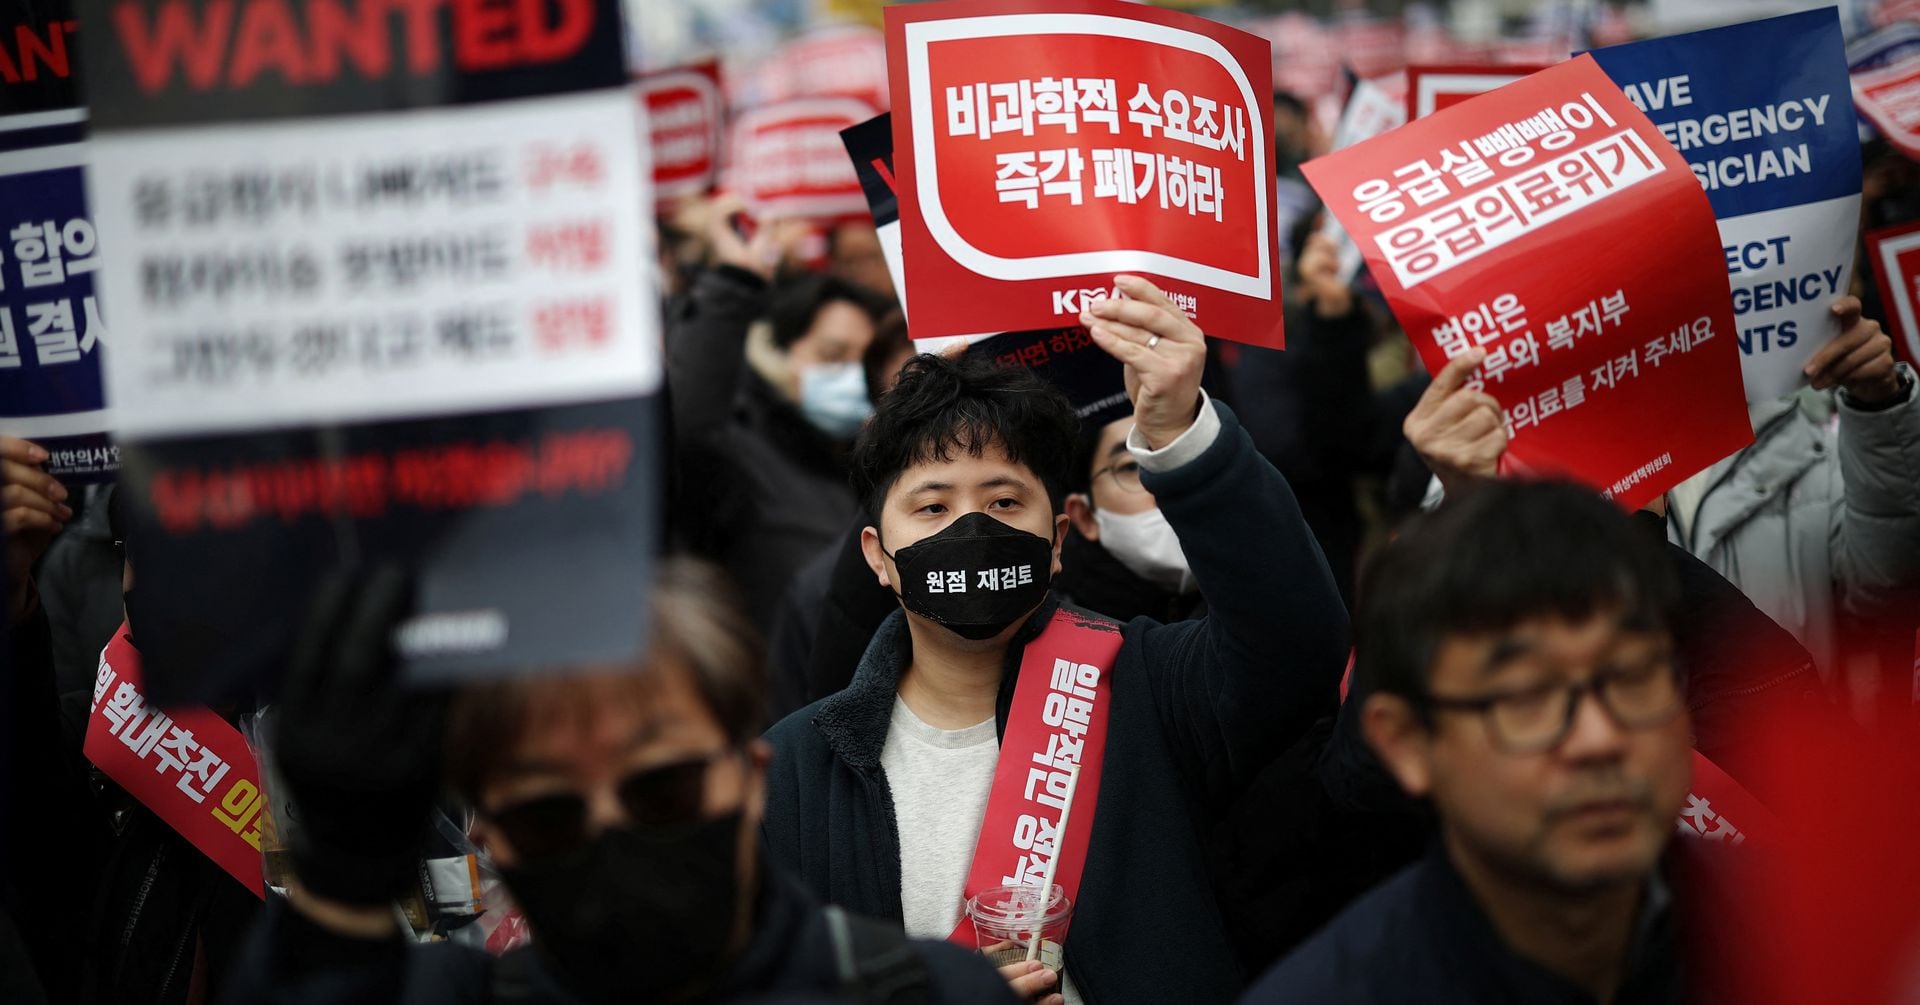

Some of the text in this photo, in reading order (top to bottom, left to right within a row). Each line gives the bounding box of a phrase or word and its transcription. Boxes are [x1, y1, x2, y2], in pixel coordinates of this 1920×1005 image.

[112, 0, 598, 93] WANTED
[946, 77, 1245, 161] 비과학적 수요조사
[1623, 74, 1693, 113] AVE
[1656, 94, 1830, 152] ERGENCY
[995, 147, 1224, 223] 즉각 폐기하라
[1353, 92, 1617, 223] 응급실뺑뺑이
[1690, 144, 1812, 192] SICIAN
[1390, 134, 1655, 274] 응급의료위기
[1722, 236, 1791, 275] ECT
[1545, 288, 1630, 351] 복지부
[1731, 265, 1843, 316] GENCY
[1431, 293, 1528, 359] 범인은
[1590, 349, 1639, 391] 지켜
[1644, 316, 1715, 367] 주세요
[1736, 321, 1798, 356] NTS
[926, 564, 1033, 593] 원점 재검토
[102, 681, 231, 804] 확대추진
[1024, 658, 1100, 810] 일방적인
